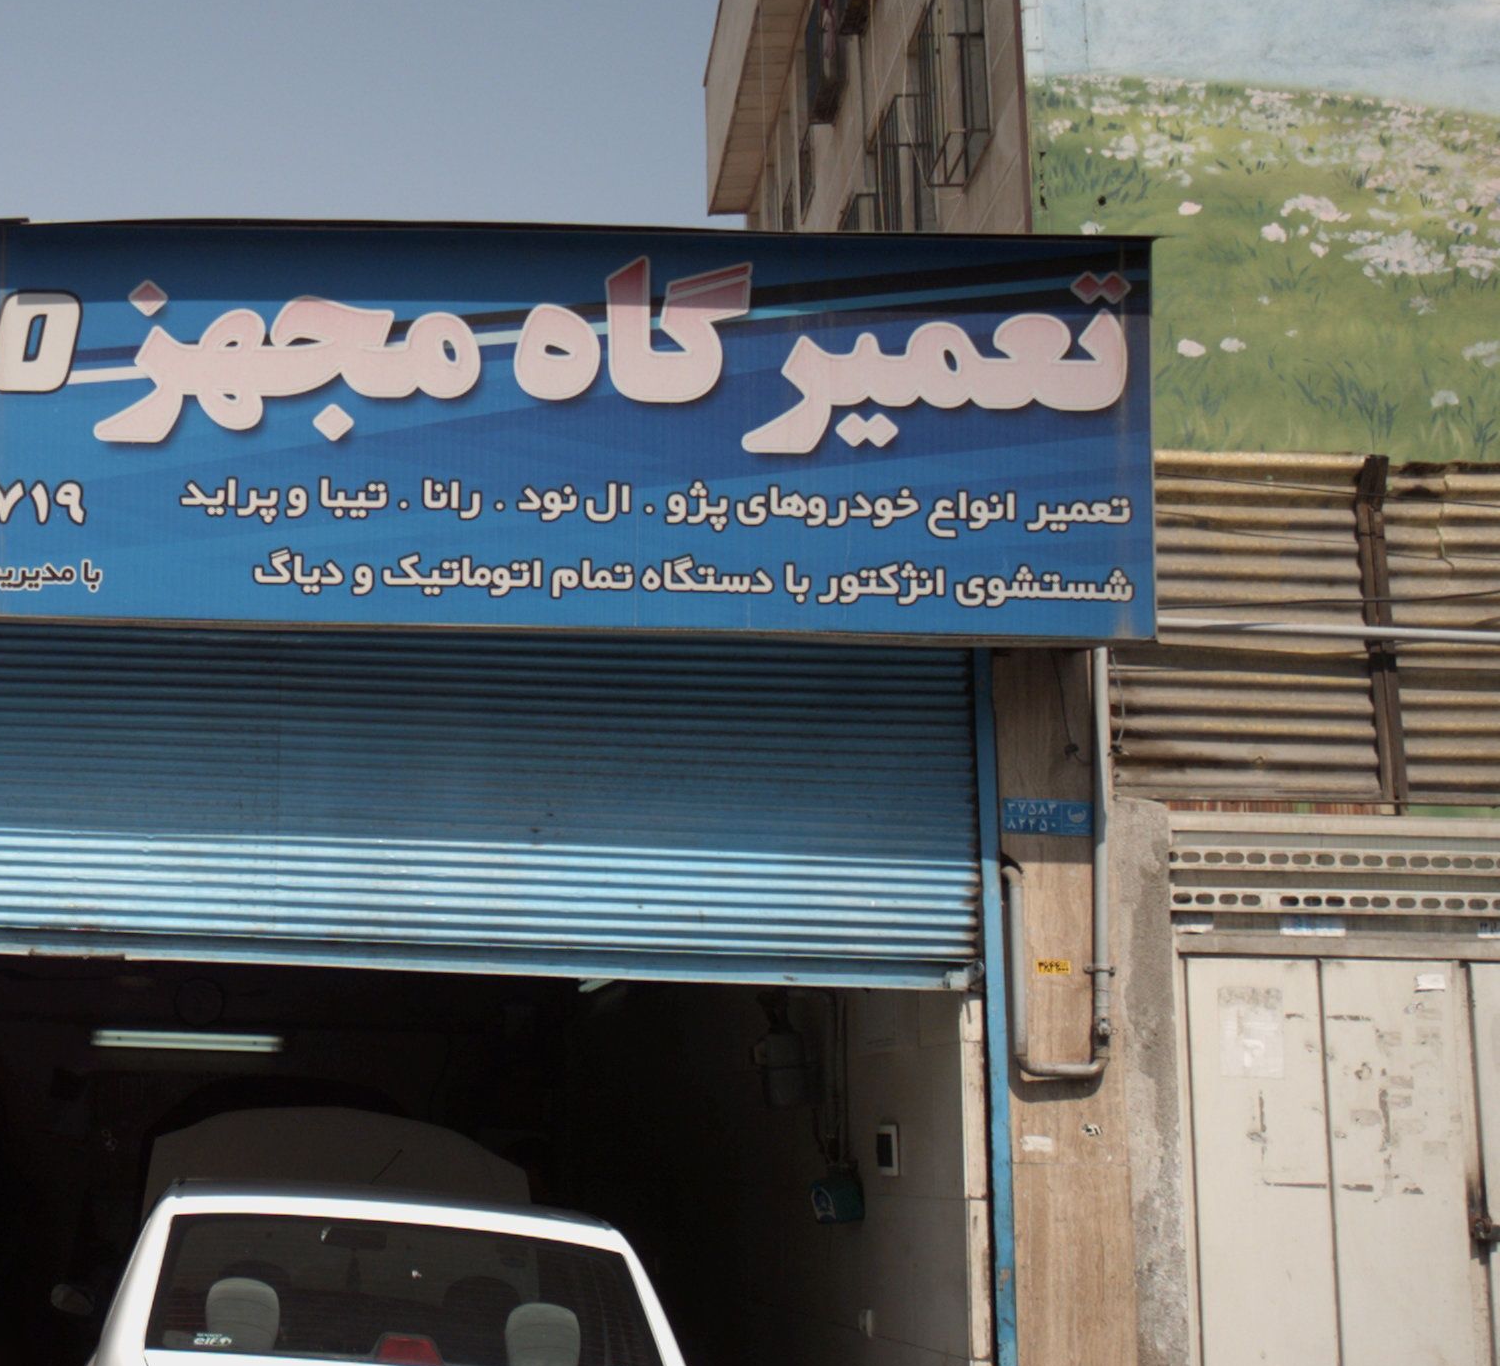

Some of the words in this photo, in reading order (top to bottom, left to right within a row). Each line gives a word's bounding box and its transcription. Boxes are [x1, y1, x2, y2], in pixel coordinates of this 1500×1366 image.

[93, 278, 482, 443] مجهز
[179, 476, 280, 524] پراید
[285, 483, 310, 518] و
[318, 476, 389, 519] تیبا
[421, 476, 483, 520] رانا
[665, 480, 730, 532] پژو
[735, 485, 921, 529] خودروهای
[927, 490, 1017, 538] انواع
[1025, 493, 1132, 533] تعمیر
[82, 559, 103, 593] با
[252, 547, 344, 595] دیاگ
[352, 561, 374, 596] و
[382, 552, 543, 597] اتوماتیک
[549, 558, 635, 598] تمام
[640, 554, 774, 595] دستگاه
[784, 561, 813, 604] با
[816, 560, 946, 605] انژکتور
[955, 564, 1134, 606] شستشوی
